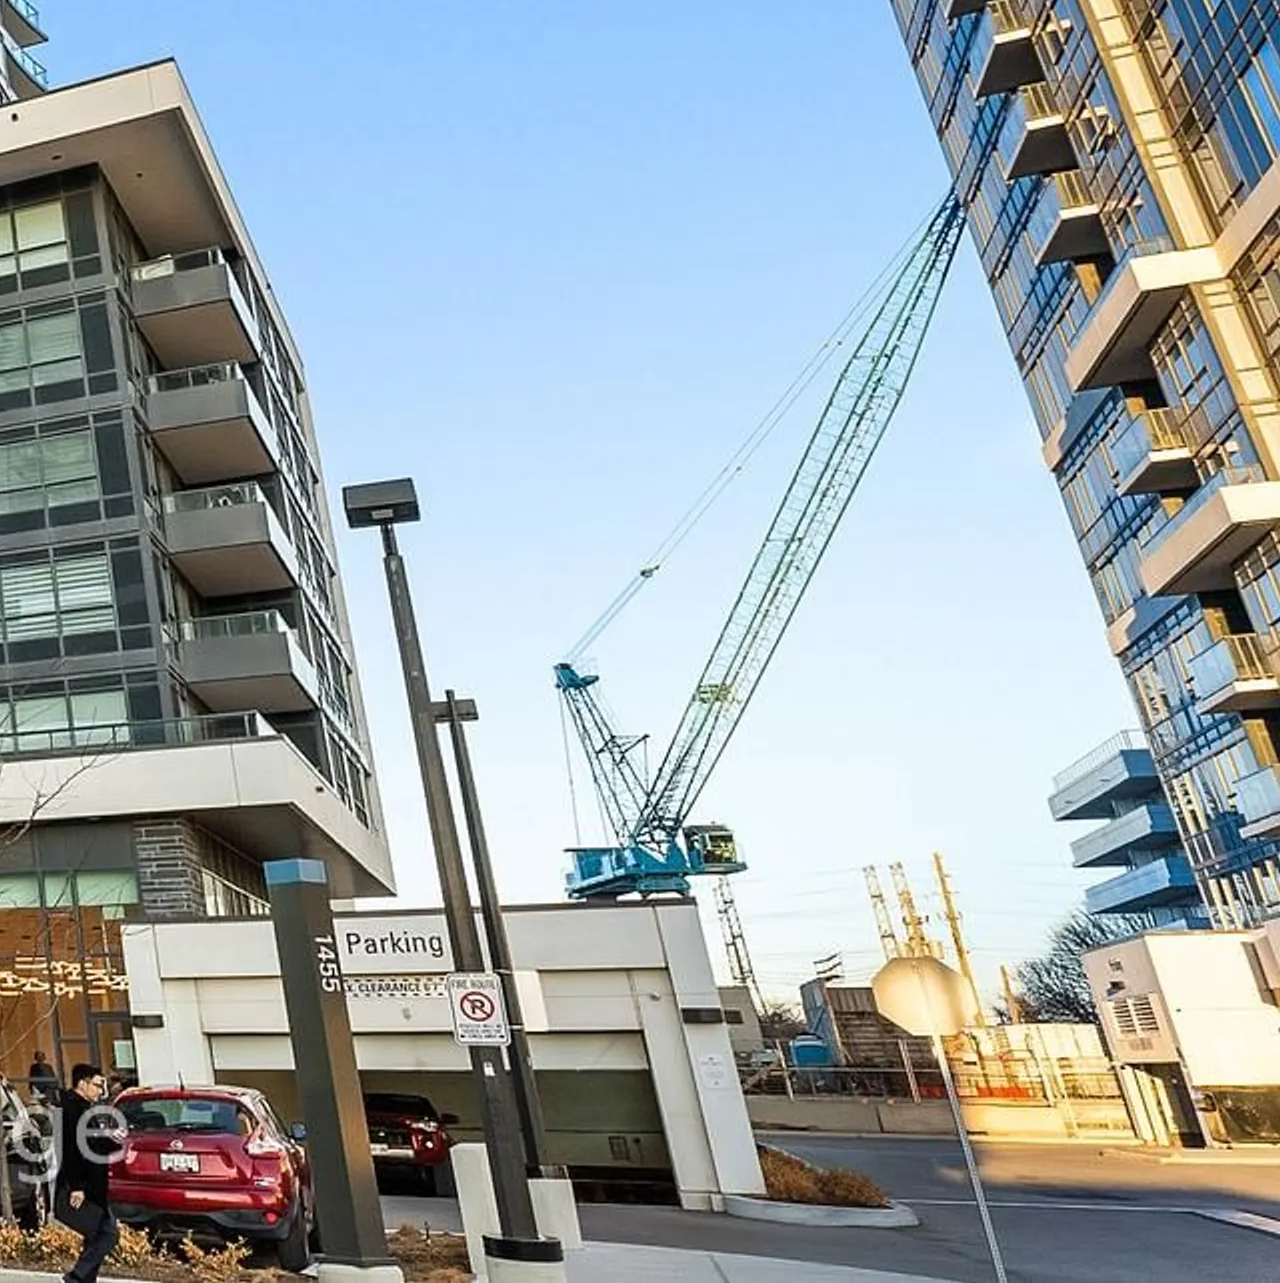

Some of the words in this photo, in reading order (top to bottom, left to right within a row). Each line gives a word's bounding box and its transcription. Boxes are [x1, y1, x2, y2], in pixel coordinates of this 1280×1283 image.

[345, 930, 444, 959] Parking
[314, 934, 341, 993] 1455
[358, 982, 422, 993] CLEARANCE
